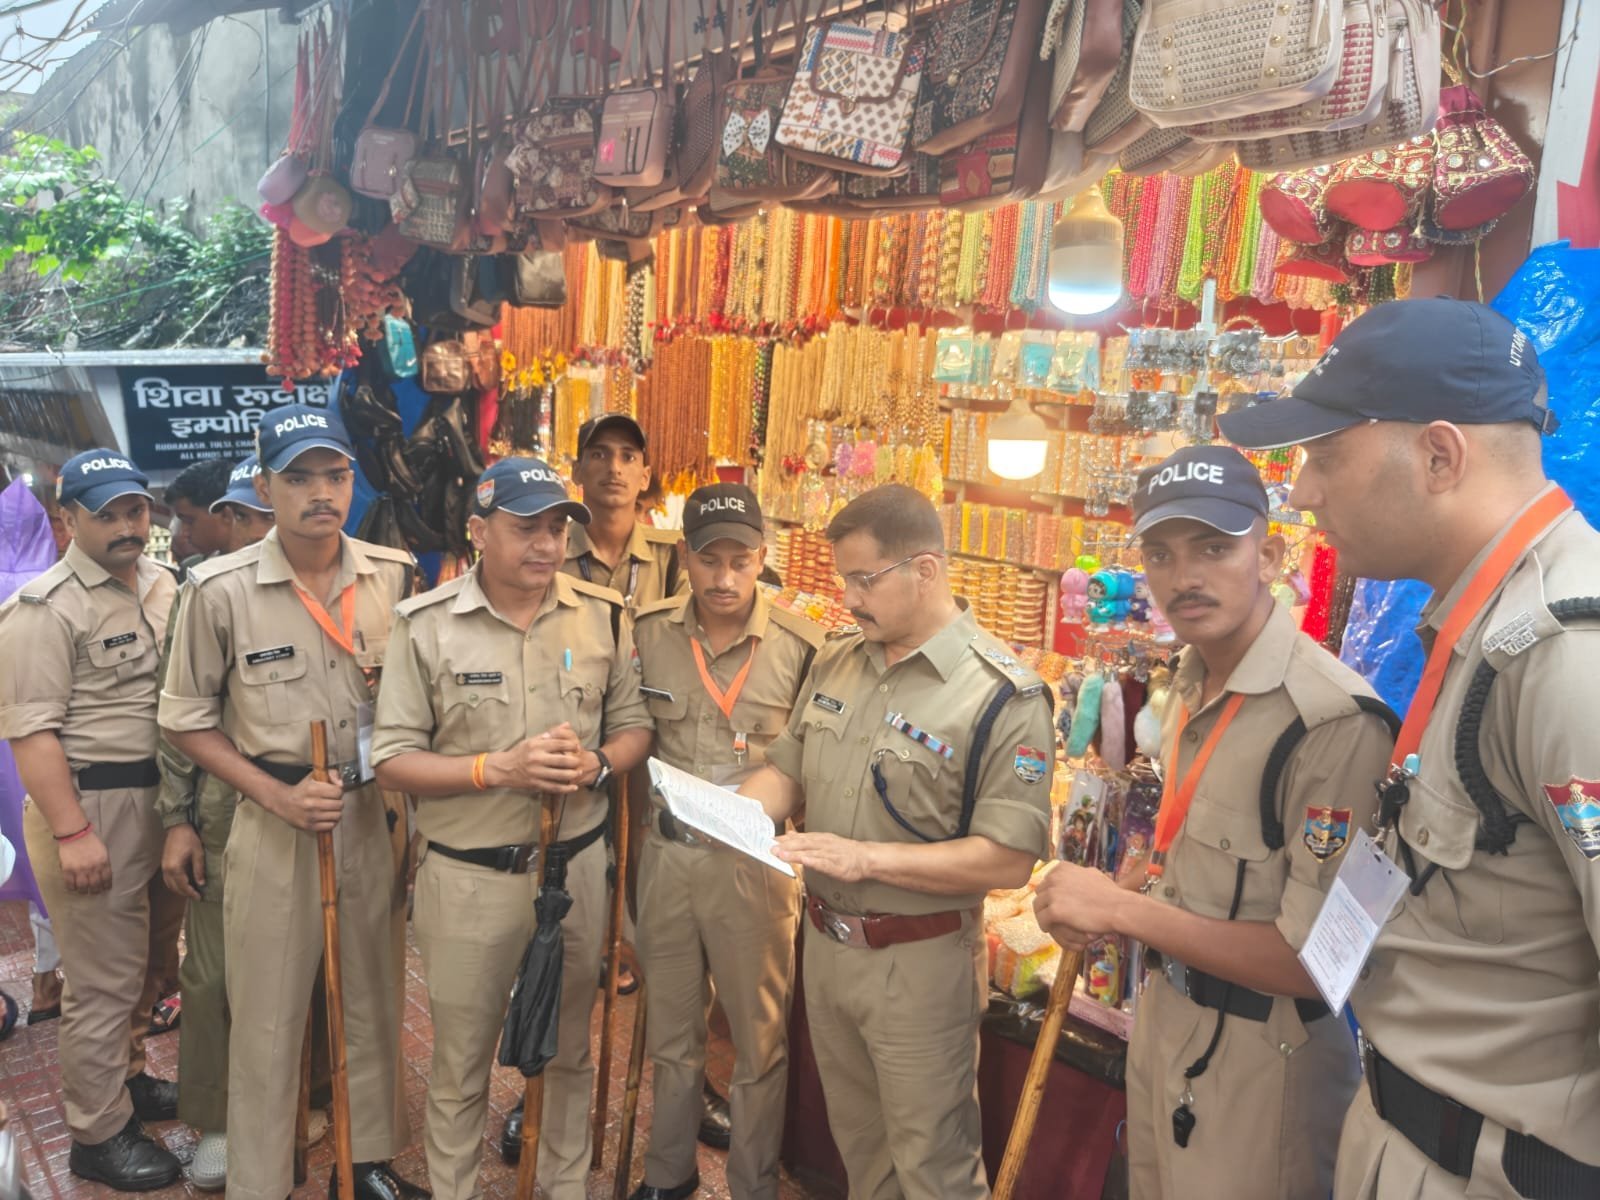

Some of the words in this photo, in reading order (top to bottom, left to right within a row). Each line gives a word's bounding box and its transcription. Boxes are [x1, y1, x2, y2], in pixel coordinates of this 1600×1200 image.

[133, 377, 223, 408] शिवा
[275, 414, 329, 437] POLICE
[81, 457, 133, 474] POLICE
[229, 463, 262, 484] POLI
[1148, 462, 1224, 495] POLICE
[700, 496, 746, 515] POLICE
